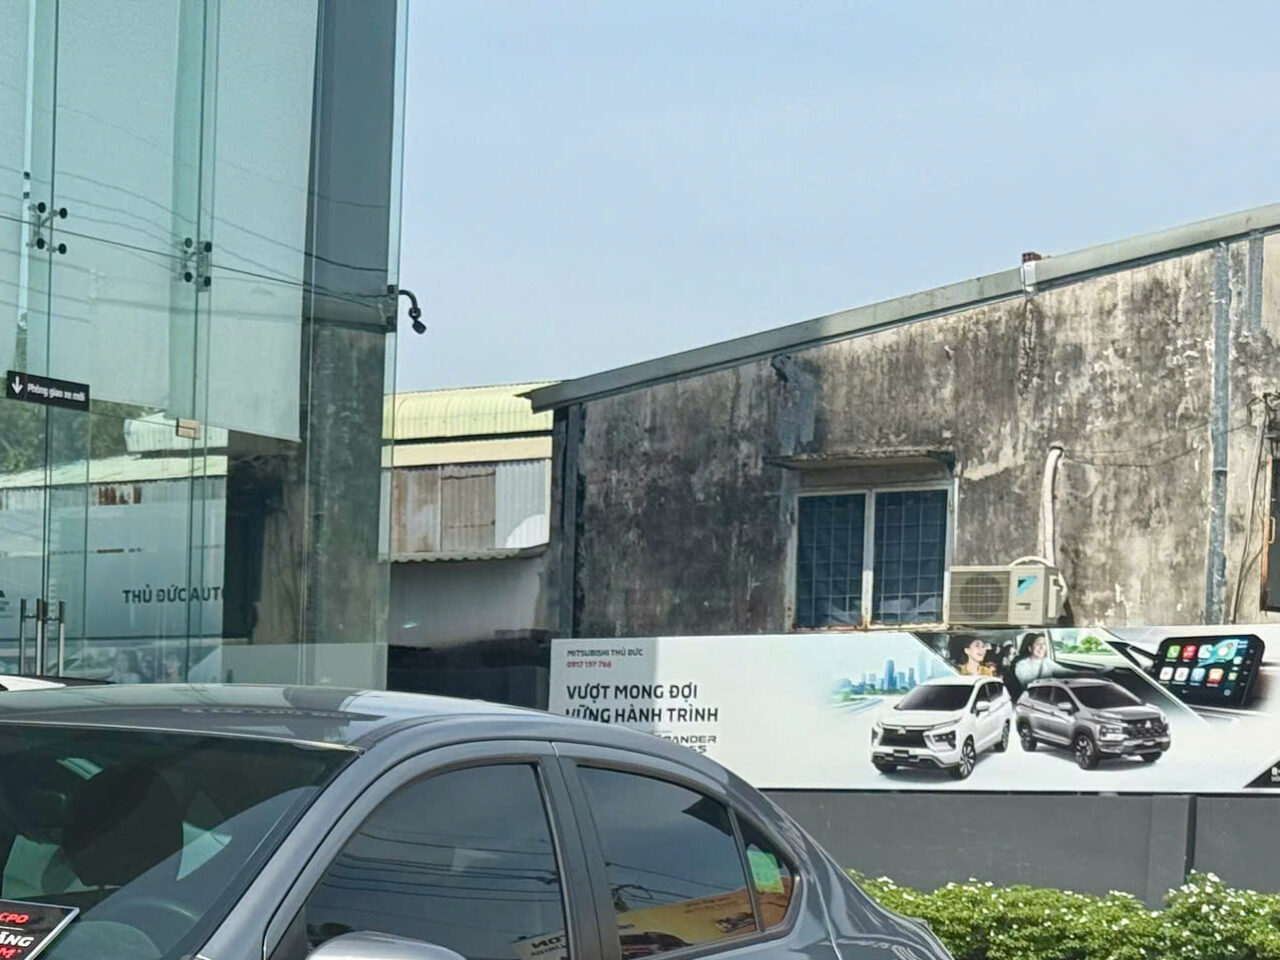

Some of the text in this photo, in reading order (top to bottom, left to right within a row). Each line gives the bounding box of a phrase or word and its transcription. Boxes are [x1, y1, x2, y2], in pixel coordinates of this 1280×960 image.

[122, 584, 224, 603] THỦ ĐỨC AUT
[567, 649, 609, 657] MITSUBISHI
[566, 682, 697, 704] VƯỢT MONG ĐỢI
[615, 703, 662, 723] HÀNH
[666, 703, 719, 723] TRÌNH
